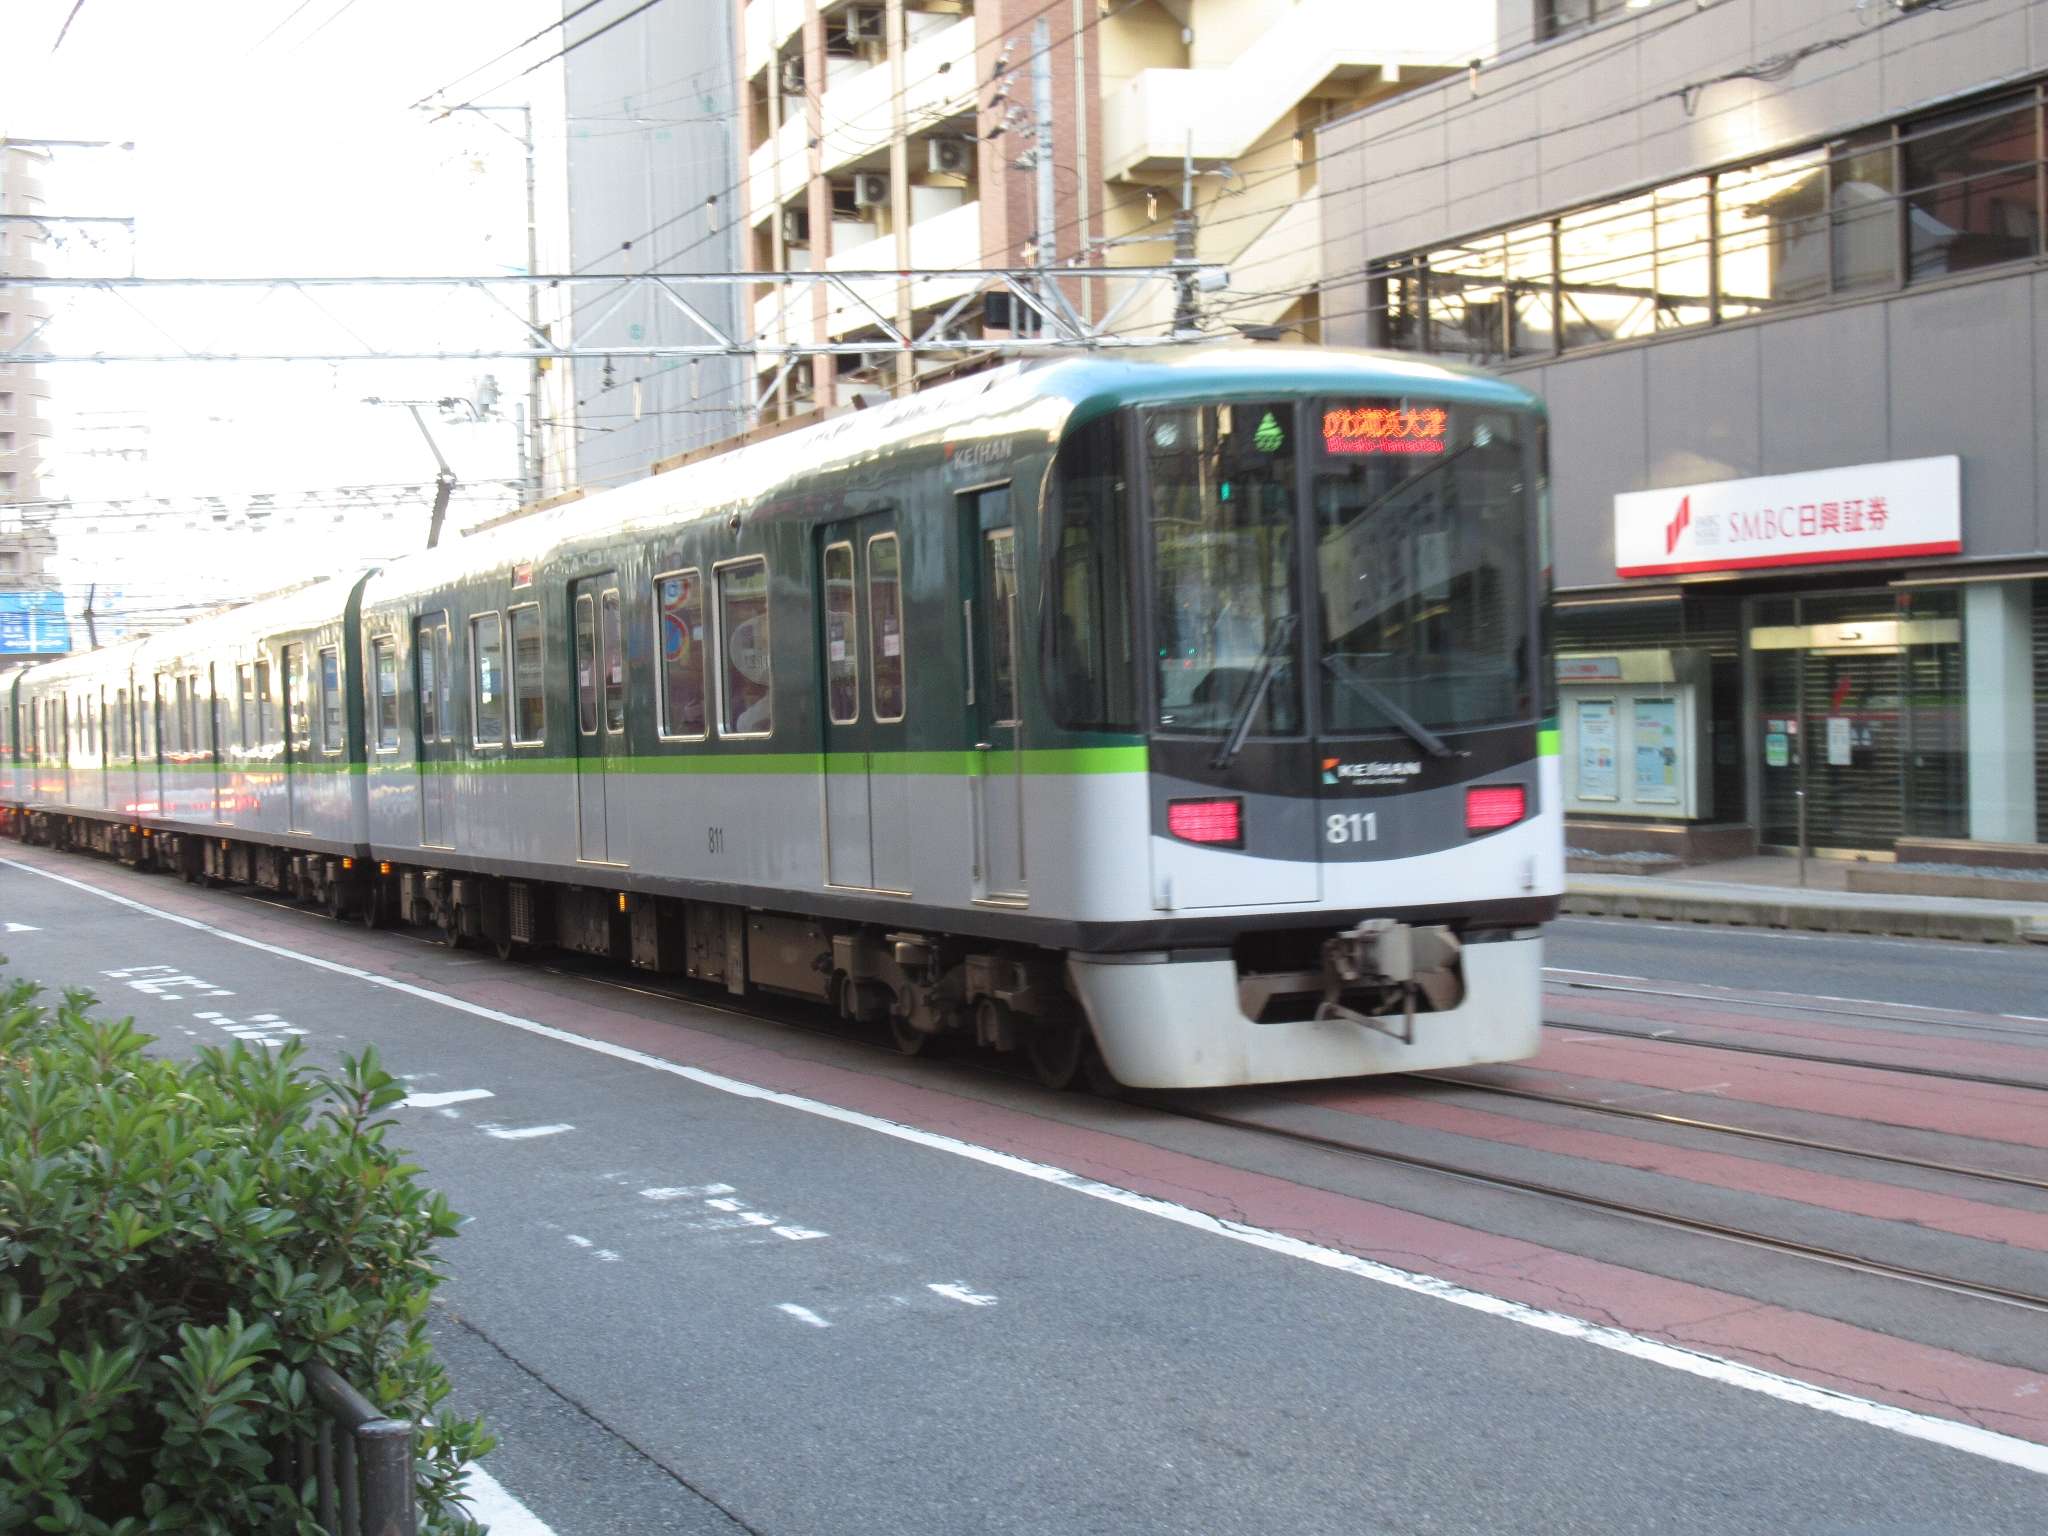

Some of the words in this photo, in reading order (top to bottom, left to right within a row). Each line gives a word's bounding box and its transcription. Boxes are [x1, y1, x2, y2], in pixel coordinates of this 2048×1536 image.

[954, 438, 1013, 470] KEIHAN
[1728, 497, 1888, 542] SMBC日興証券
[1338, 761, 1421, 777] KEIHAN
[708, 826, 724, 855] 811
[1326, 812, 1377, 844] 811
